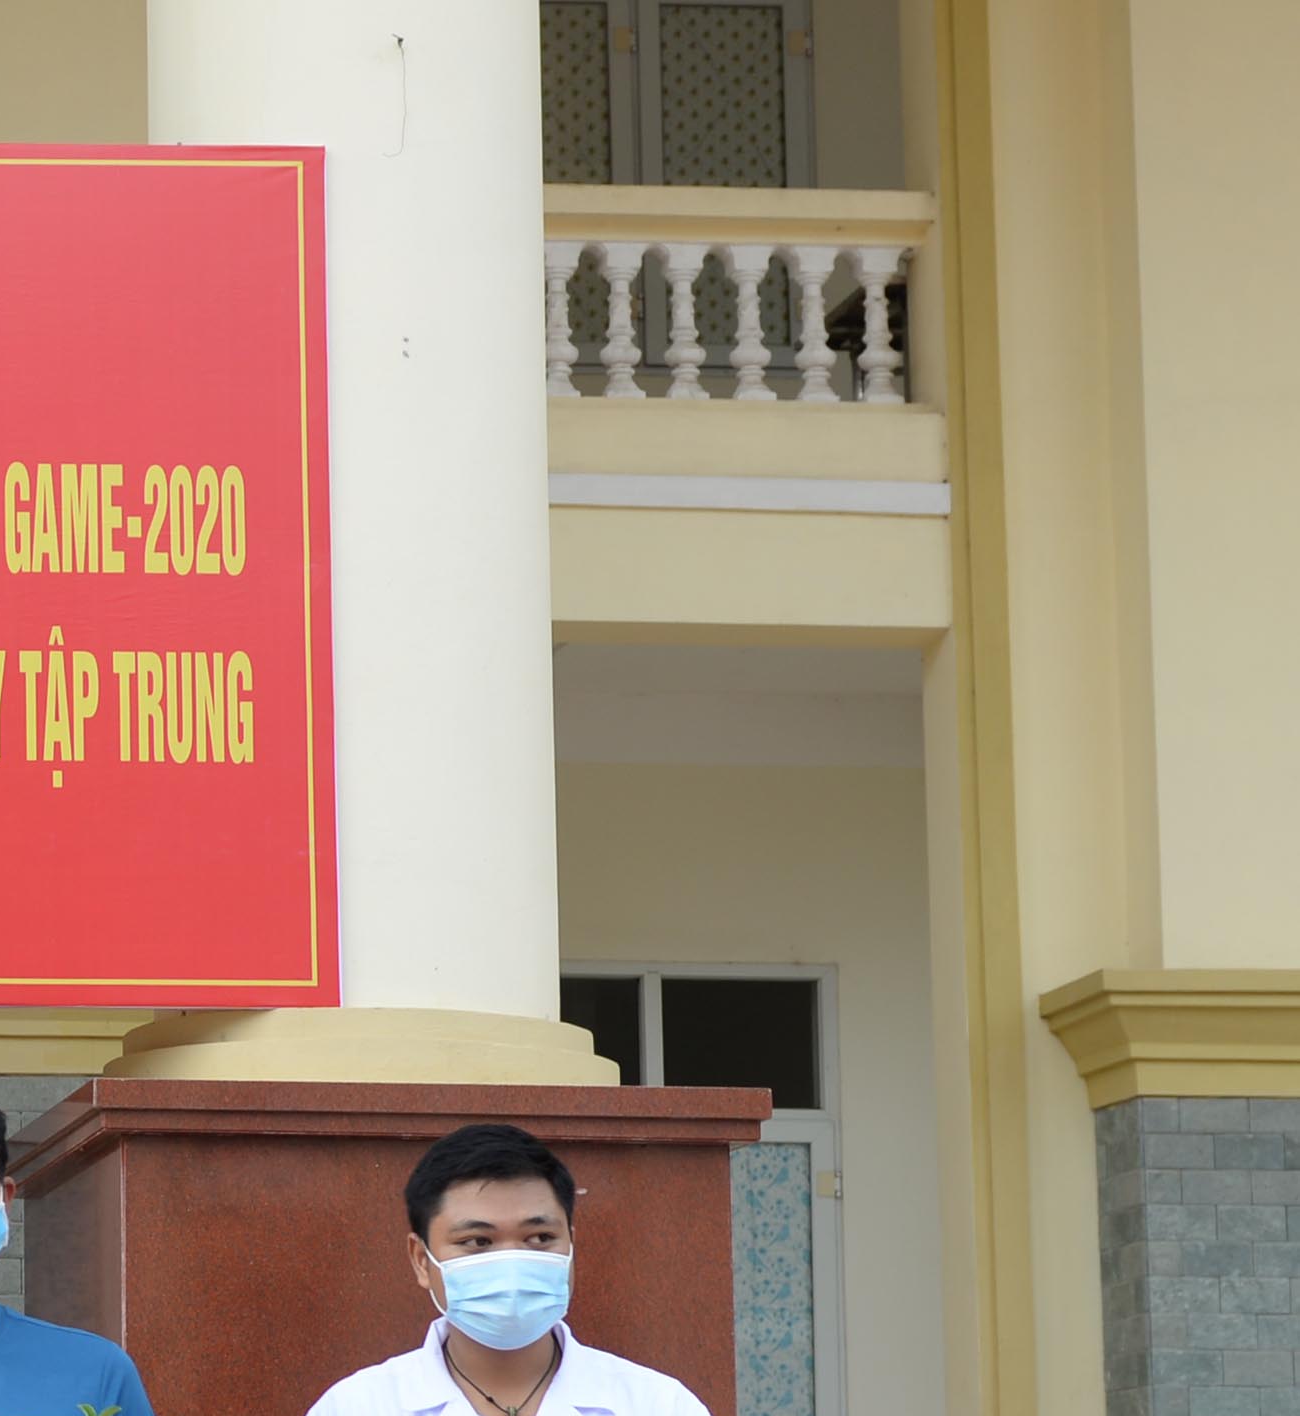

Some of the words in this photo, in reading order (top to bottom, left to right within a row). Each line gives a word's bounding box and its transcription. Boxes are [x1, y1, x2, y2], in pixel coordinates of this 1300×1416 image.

[4, 460, 247, 577] GAME-2020
[19, 624, 101, 789] TẬP
[112, 650, 256, 765] TRUNG
